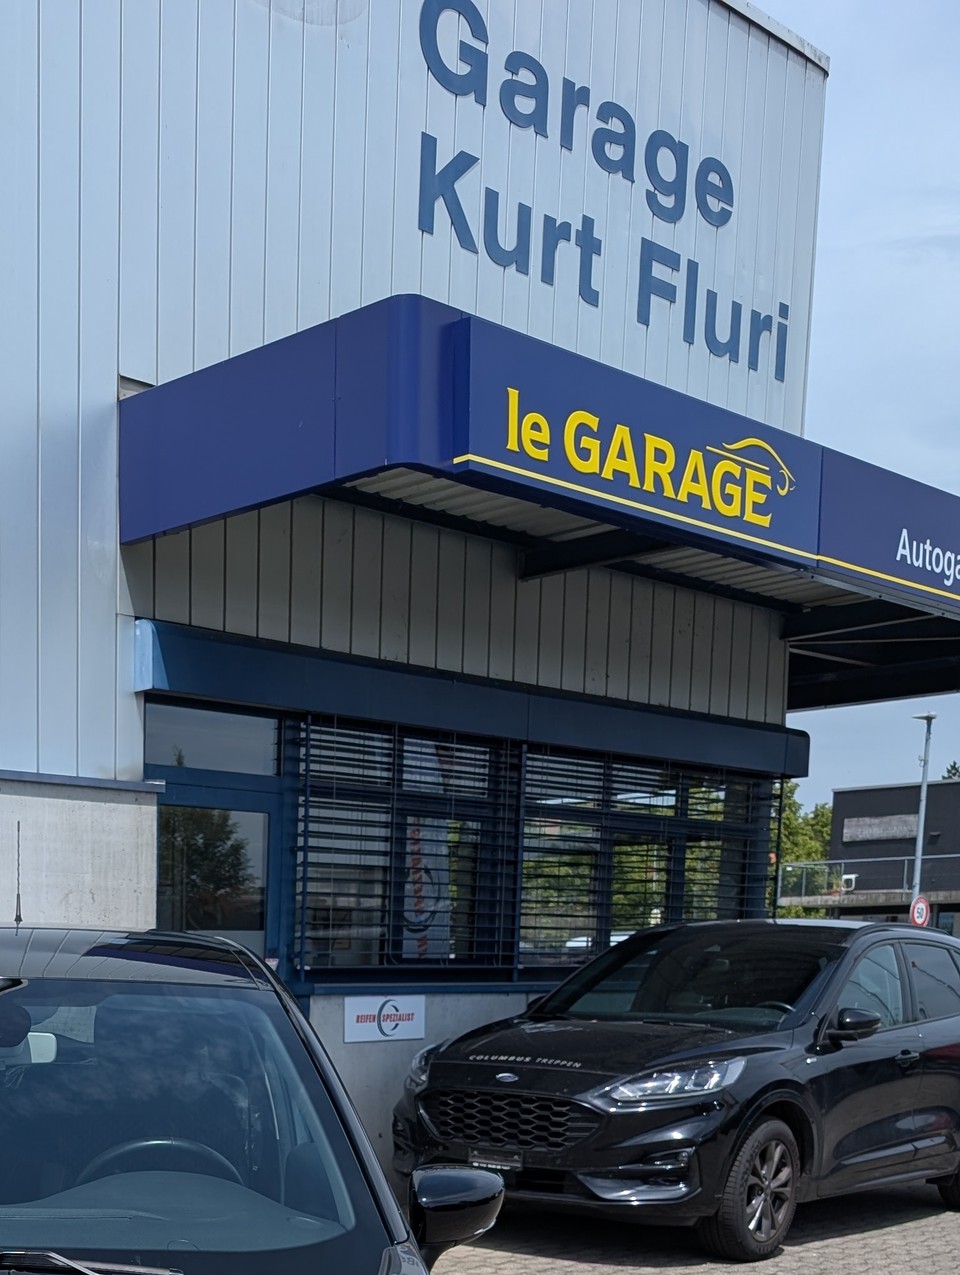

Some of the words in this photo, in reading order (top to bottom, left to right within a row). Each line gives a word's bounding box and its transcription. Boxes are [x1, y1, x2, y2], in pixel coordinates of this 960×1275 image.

[419, 0, 735, 227] Garage
[418, 131, 602, 307] Kurt
[637, 236, 790, 382] Fluri
[506, 387, 551, 462] le
[563, 410, 773, 528] GARAGE
[916, 907, 925, 919] 50
[355, 1014, 377, 1024] REIFEN
[381, 1012, 415, 1023] SPEZIALIST
[468, 1054, 532, 1063] COLUMBUS
[535, 1057, 582, 1068] TREPPEN
